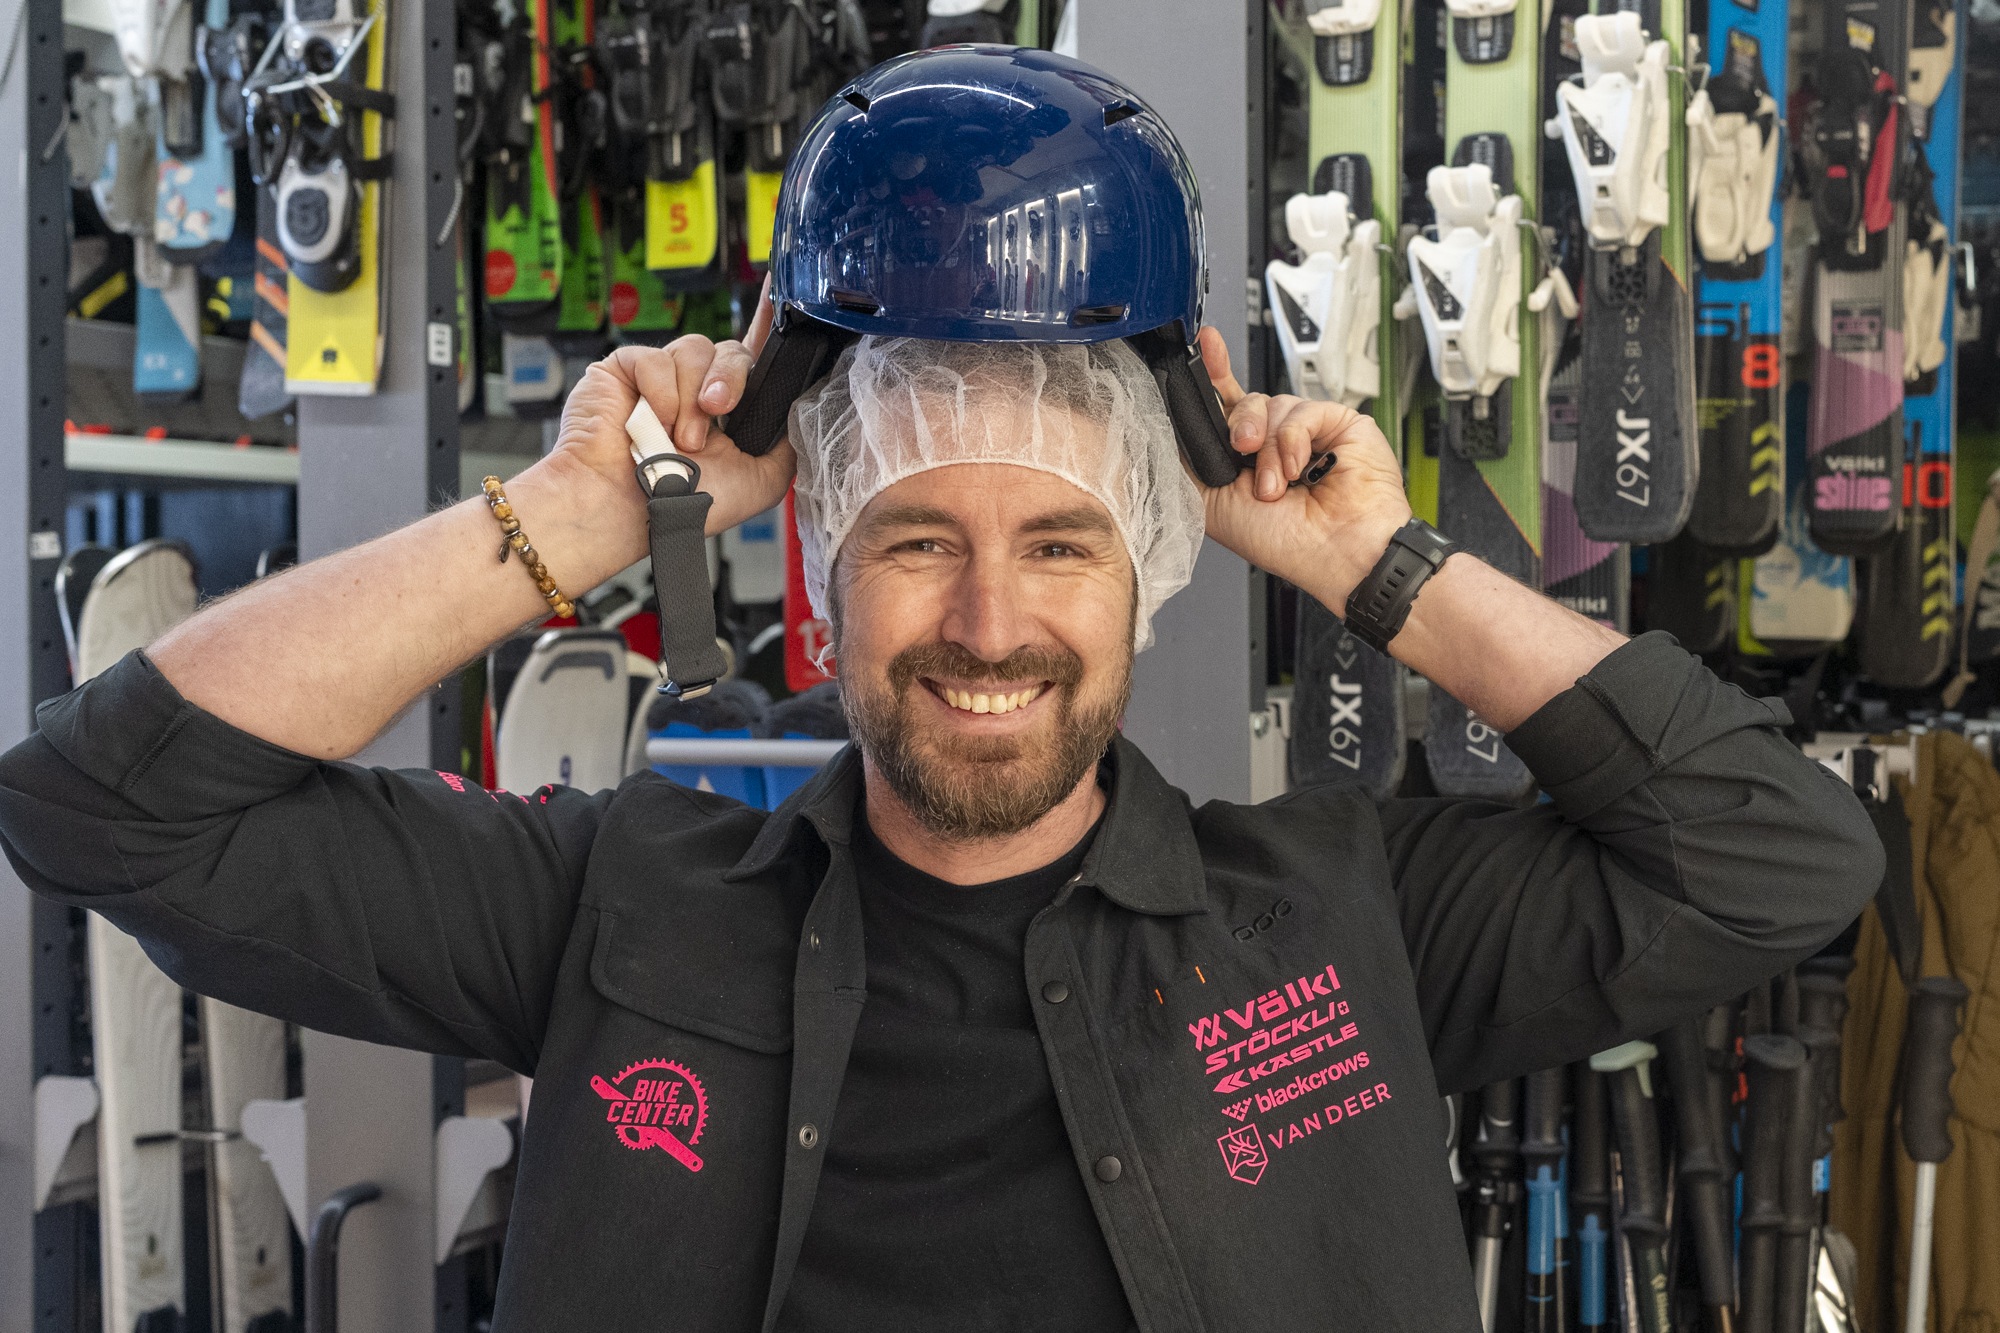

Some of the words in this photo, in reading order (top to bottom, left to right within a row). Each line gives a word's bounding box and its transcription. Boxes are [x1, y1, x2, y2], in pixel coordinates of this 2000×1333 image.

[671, 203, 689, 234] 5
[1742, 344, 1779, 388] 8
[1616, 409, 1650, 507] JX67
[1902, 461, 1951, 508] 10
[1329, 673, 1362, 770] JX67
[1205, 1001, 1335, 1075] STÖCKLI
[632, 1079, 684, 1104] BIKE
[1254, 1051, 1371, 1113] blackcrows
[606, 1101, 695, 1127] CENTER
[1268, 1112, 1322, 1149] VAN
[1324, 1082, 1393, 1125] DEER
